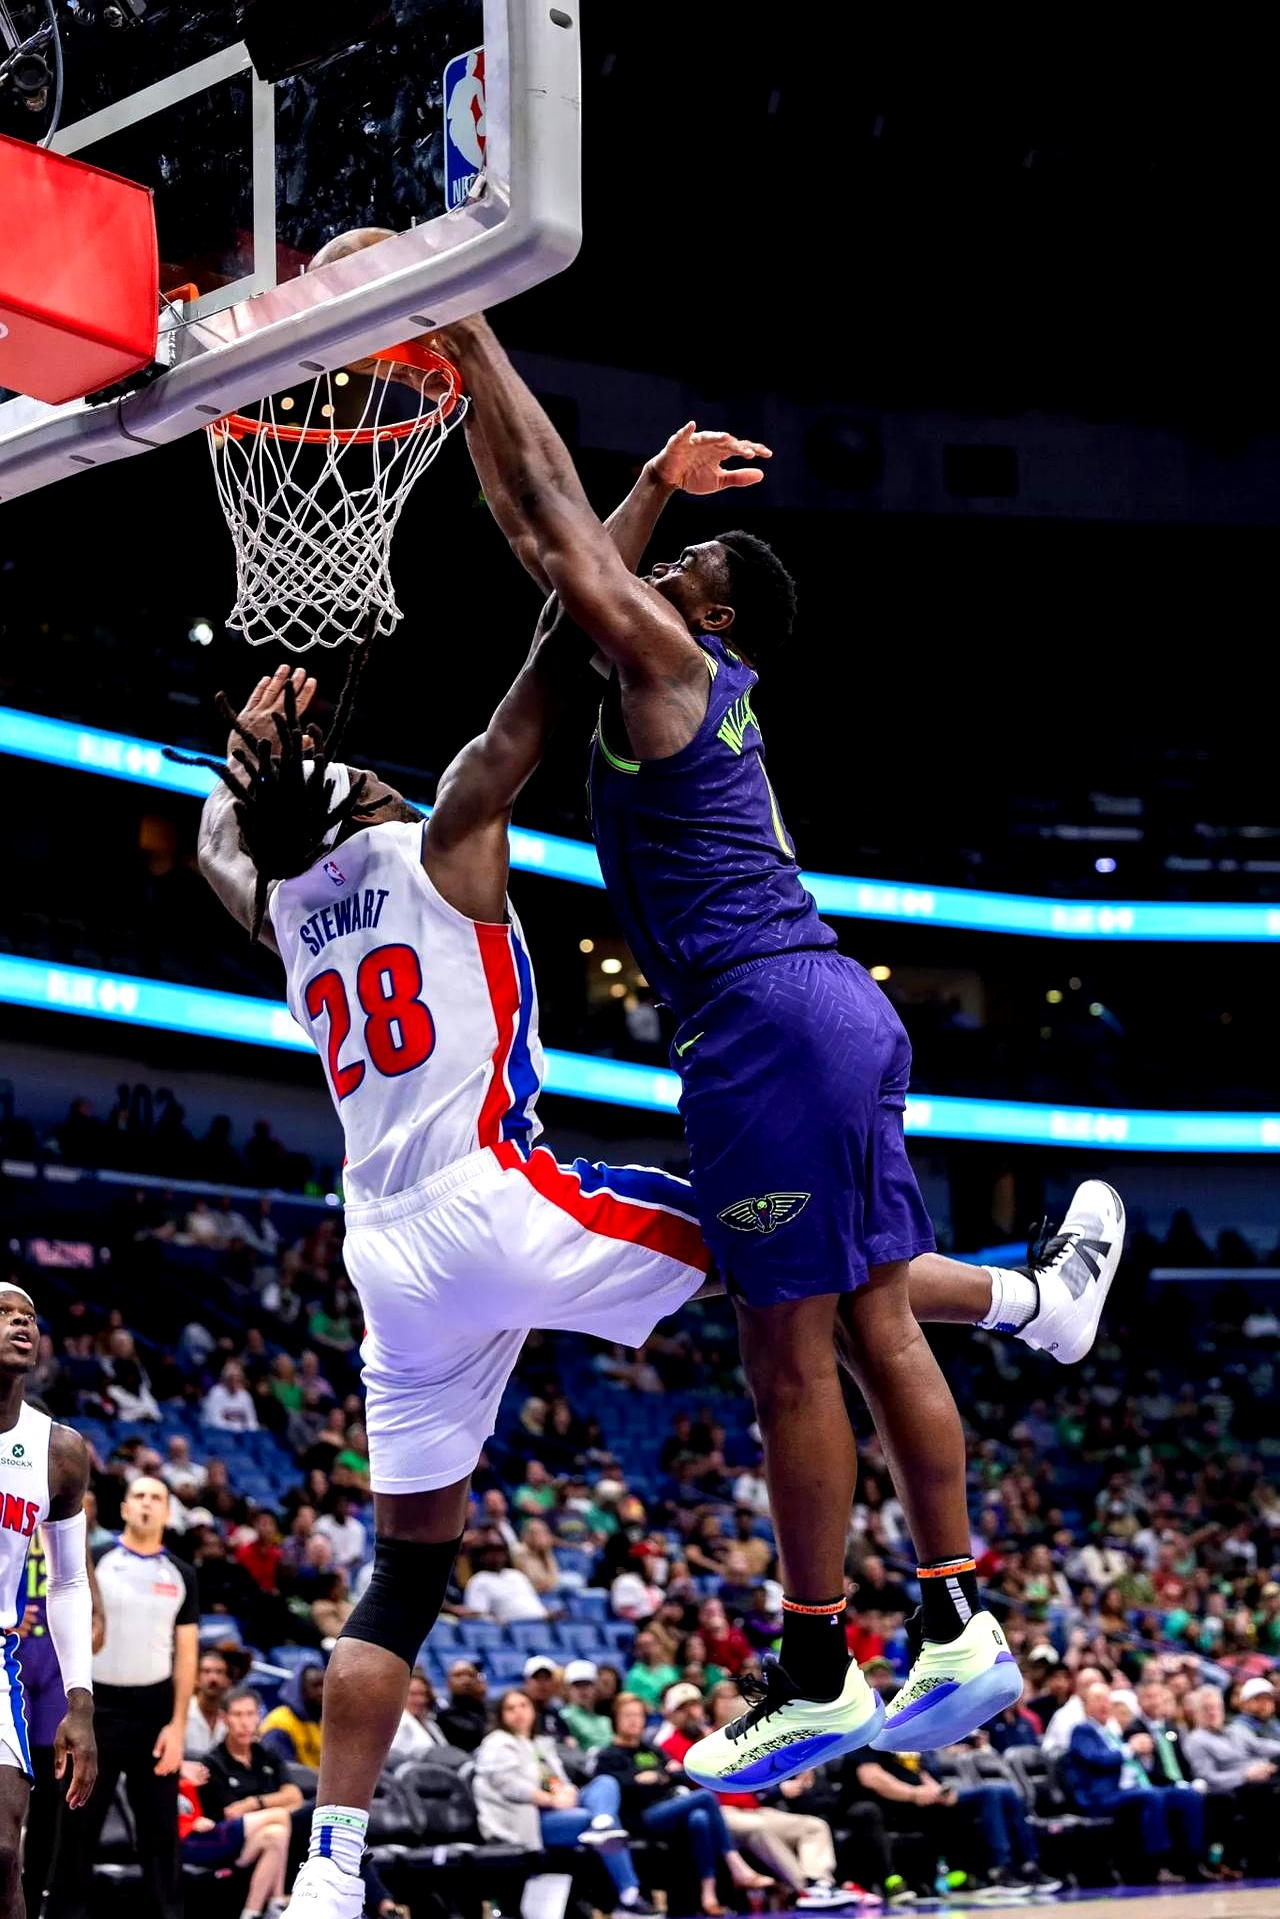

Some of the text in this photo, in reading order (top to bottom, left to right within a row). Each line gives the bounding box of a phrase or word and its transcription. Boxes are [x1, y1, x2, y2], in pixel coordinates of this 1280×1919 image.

[300, 889, 389, 956] STEWART
[305, 943, 436, 1101] 28
[0, 1491, 40, 1537] NS
